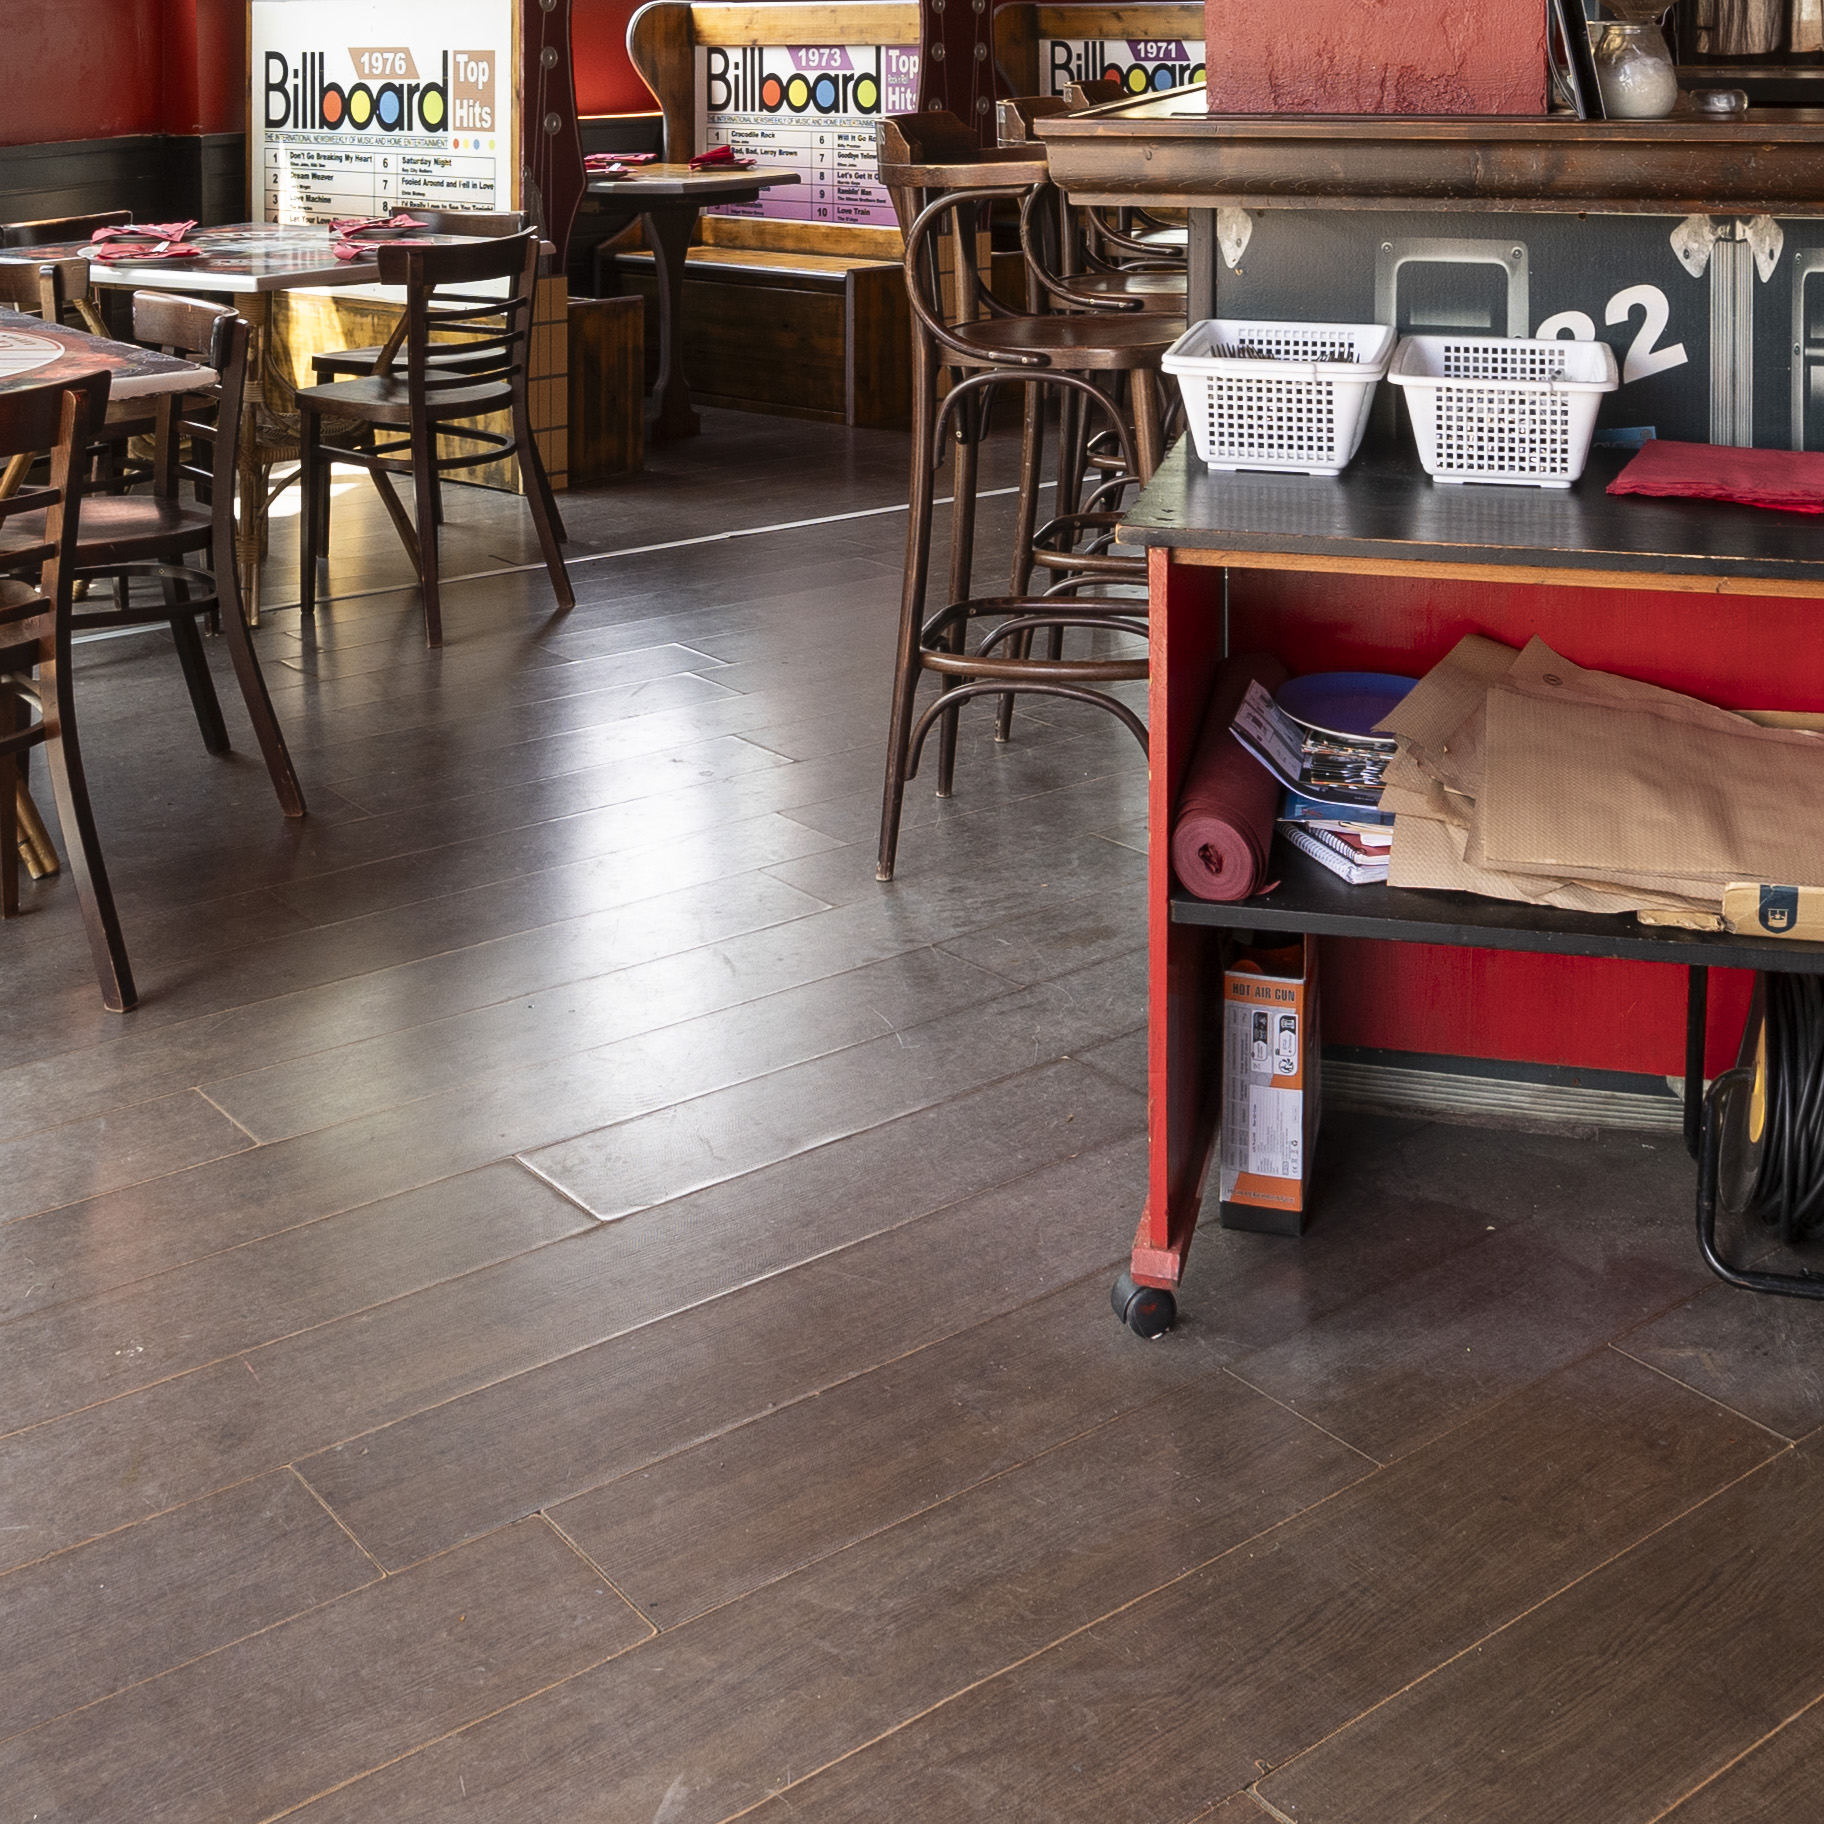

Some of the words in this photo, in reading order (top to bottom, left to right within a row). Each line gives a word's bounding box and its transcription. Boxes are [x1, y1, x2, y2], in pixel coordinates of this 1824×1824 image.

[1137, 42, 1177, 58] 1971
[797, 47, 842, 67] 1973
[360, 52, 407, 76] 1976
[888, 52, 918, 79] Top
[455, 53, 489, 90] Top
[707, 46, 882, 114] Billboard
[264, 49, 449, 133] Billboard
[454, 99, 492, 129] Hits
[265, 133, 275, 141] THE
[275, 134, 312, 143] INTERNATIONAL
[349, 136, 356, 144] OF
[387, 138, 402, 146] HOME
[404, 138, 448, 147] ENTERTAINMENT
[715, 132, 719, 140] 1
[819, 136, 824, 144] 6
[273, 153, 277, 163] 1
[290, 151, 305, 159] Don't
[307, 152, 314, 160] Go
[317, 153, 343, 163] Breaking
[345, 154, 353, 163] My
[355, 154, 372, 163] Heart
[760, 148, 776, 157] Leroy
[819, 154, 824, 162] 7
[838, 152, 858, 160] Goodbye
[383, 158, 388, 168] 6
[402, 157, 431, 167] Saturday
[433, 158, 452, 168] Night
[273, 174, 278, 184] 2
[311, 173, 334, 181] Weaver
[819, 172, 825, 180] 8
[383, 180, 388, 190] 7
[402, 177, 421, 186] Fooled
[423, 178, 444, 187] Around
[446, 180, 457, 188] and
[472, 181, 477, 189] in
[479, 182, 494, 190] Love
[273, 195, 278, 204] 3
[305, 195, 332, 203] Machine
[819, 190, 825, 198] 9
[383, 201, 388, 212] 8
[817, 208, 828, 217] 10
[1232, 983, 1251, 997] HOT
[1254, 986, 1272, 999] AIR
[1274, 988, 1296, 1002] GUN
